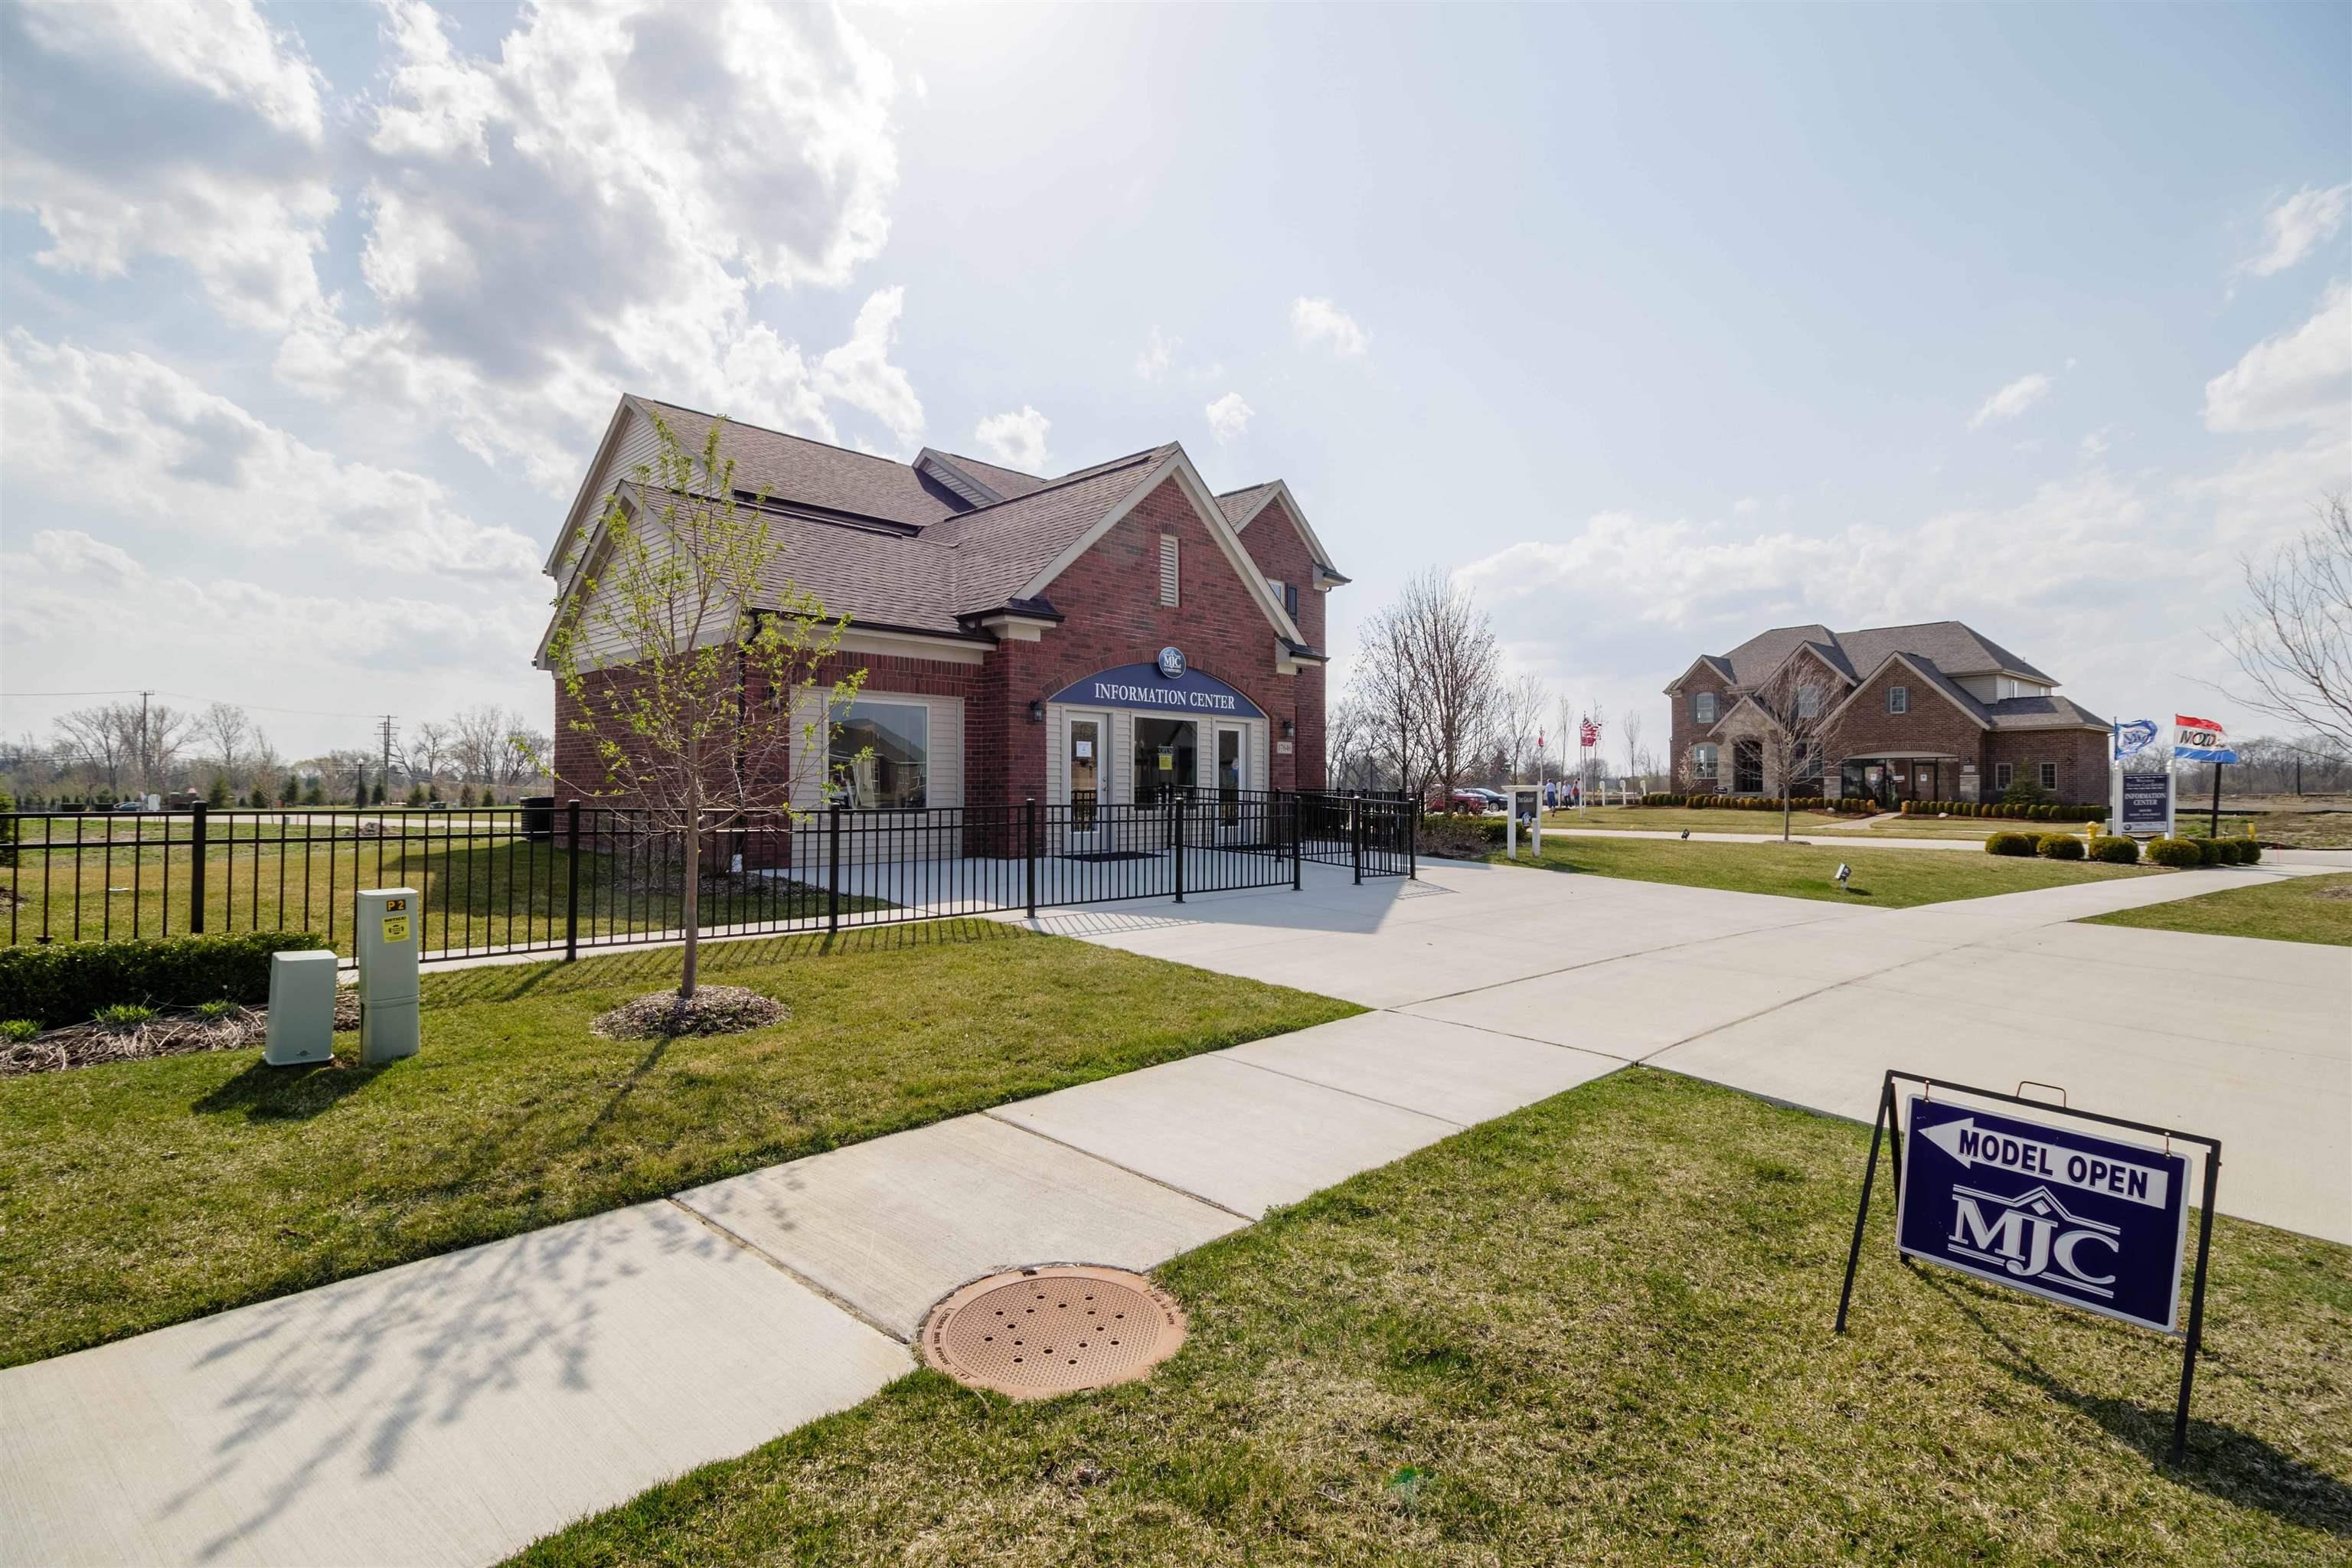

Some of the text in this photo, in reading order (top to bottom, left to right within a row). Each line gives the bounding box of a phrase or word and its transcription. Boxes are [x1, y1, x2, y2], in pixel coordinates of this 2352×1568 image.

[1095, 683, 1235, 710] INFORMATION CENTER
[387, 900, 404, 911] P 2
[1958, 1129, 2148, 1200] MODEL OPEN
[1948, 1194, 2119, 1285] MJC
[936, 1312, 950, 1329] WORKS
[935, 1347, 952, 1365] JORDAN
